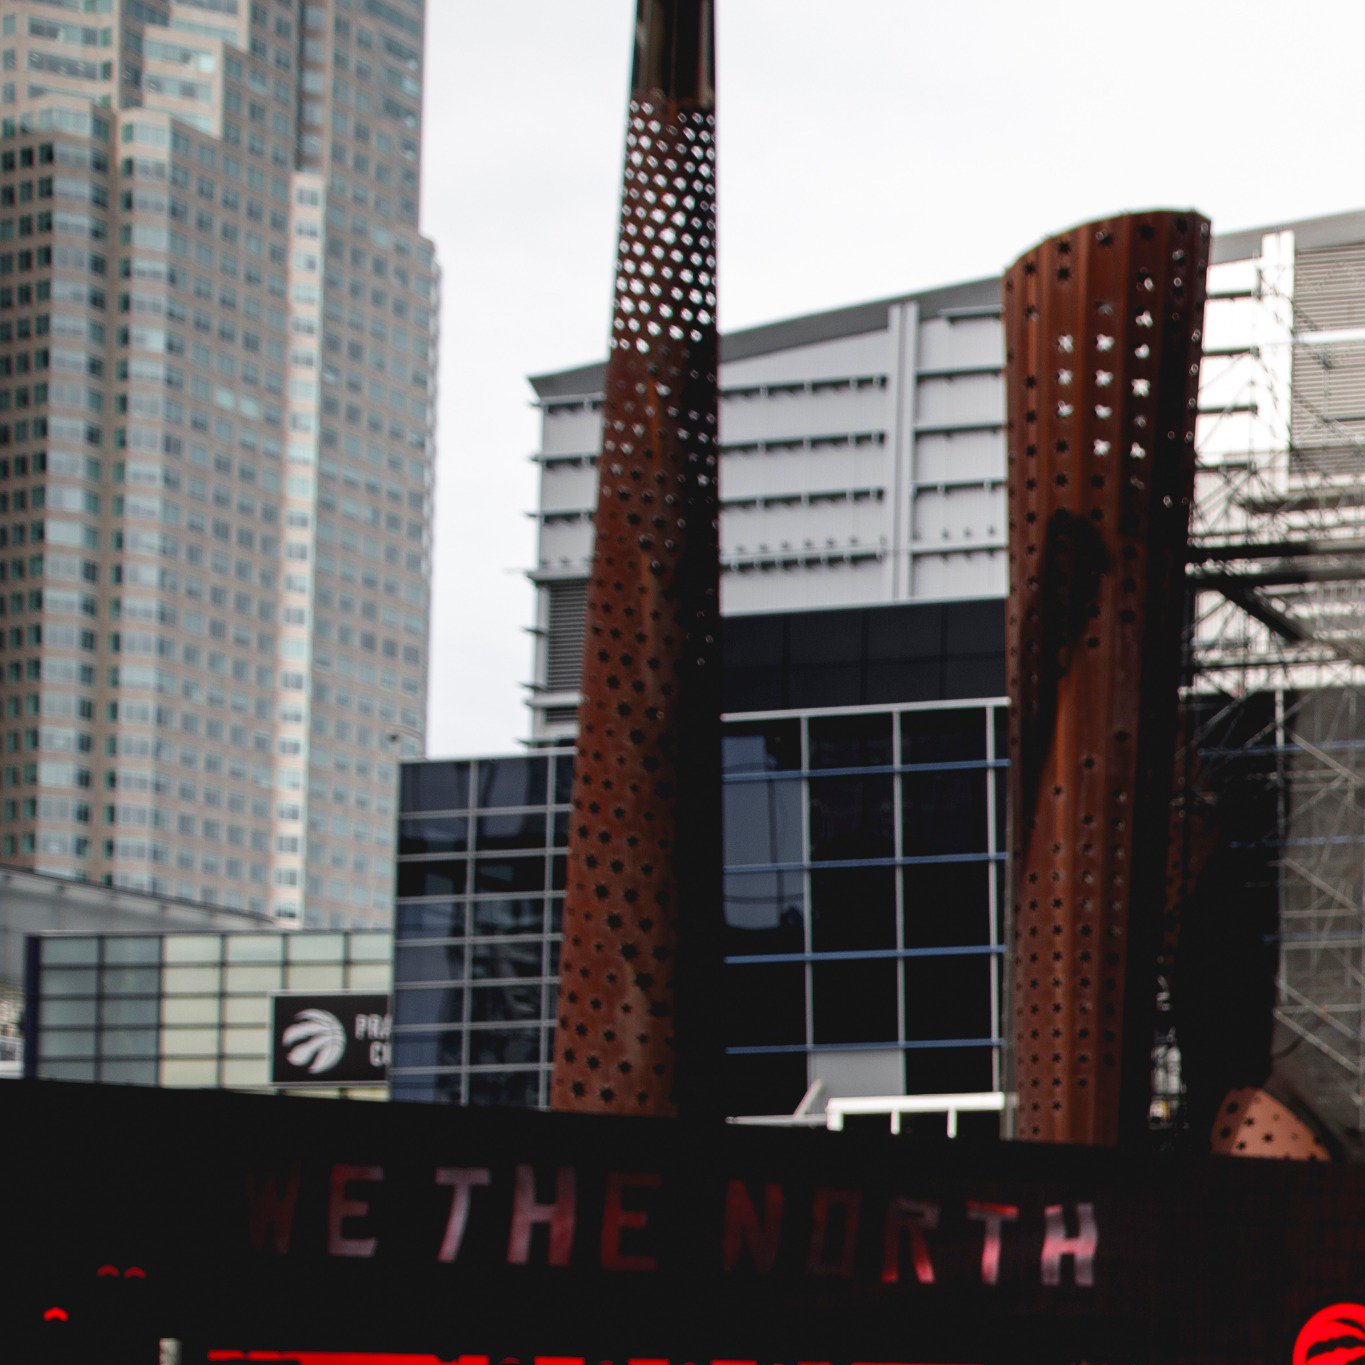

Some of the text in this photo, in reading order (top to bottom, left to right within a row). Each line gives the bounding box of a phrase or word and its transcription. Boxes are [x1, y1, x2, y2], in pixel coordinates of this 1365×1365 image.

[243, 1157, 1099, 1287] WE THE NORTH
